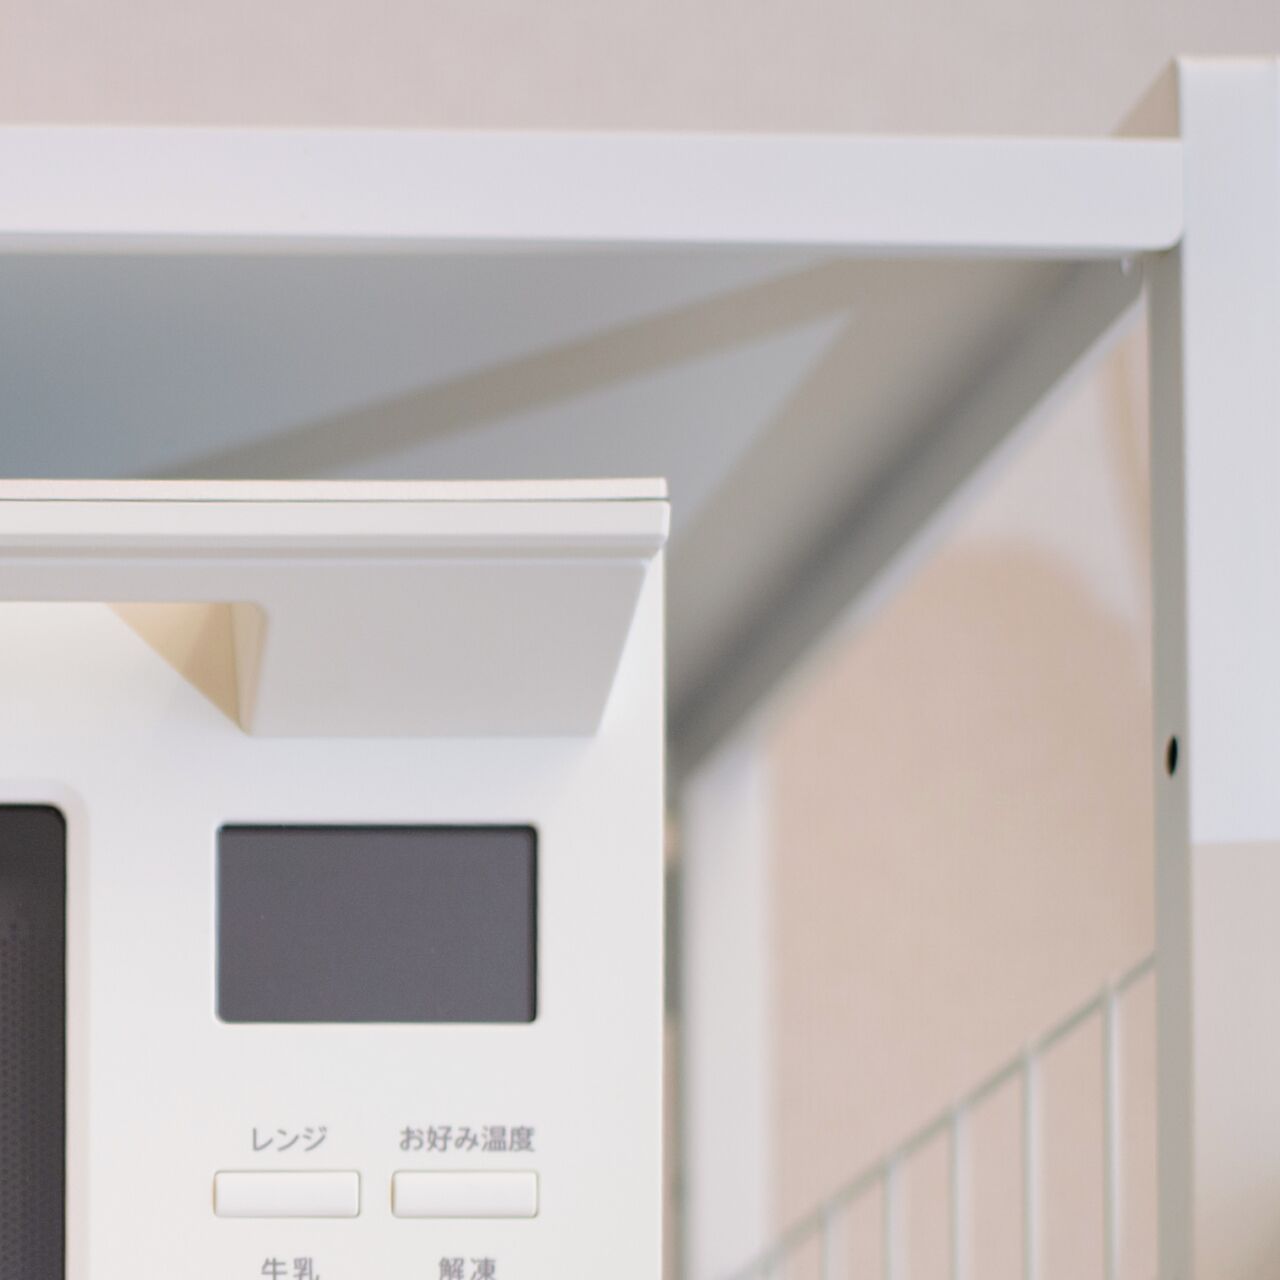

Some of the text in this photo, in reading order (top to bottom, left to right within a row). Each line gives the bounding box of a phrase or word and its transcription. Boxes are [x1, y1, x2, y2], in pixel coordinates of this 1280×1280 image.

[252, 1125, 328, 1153] レンジ
[399, 1124, 535, 1153] お好み温度
